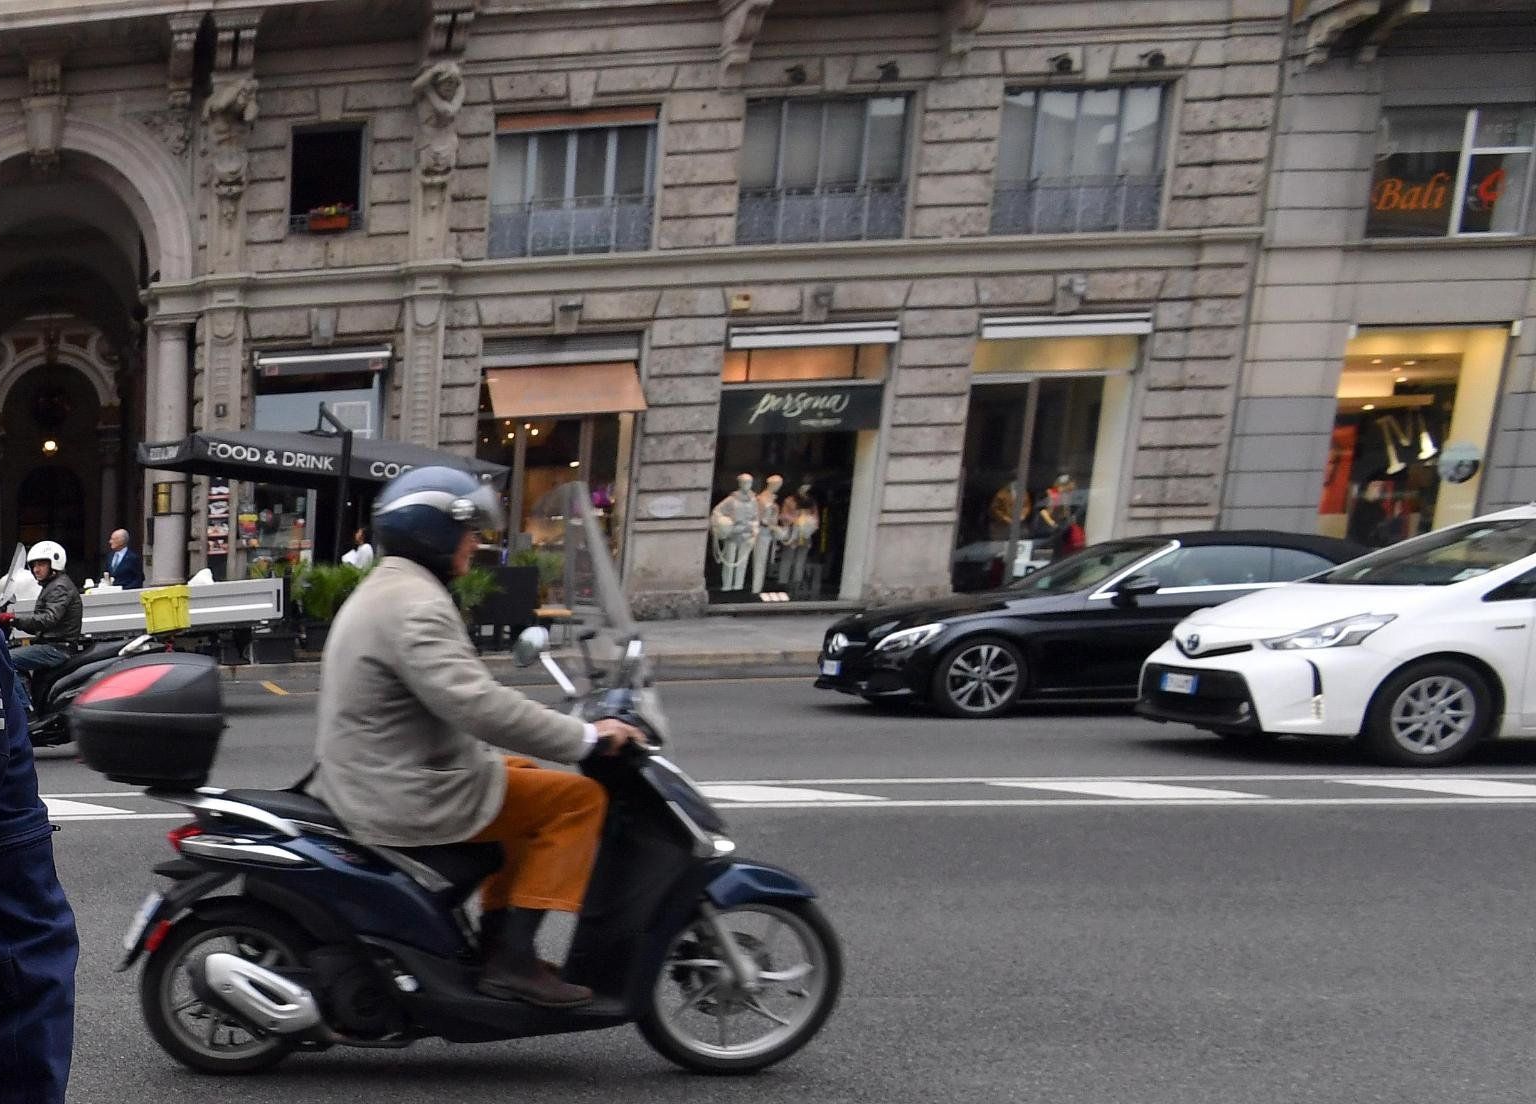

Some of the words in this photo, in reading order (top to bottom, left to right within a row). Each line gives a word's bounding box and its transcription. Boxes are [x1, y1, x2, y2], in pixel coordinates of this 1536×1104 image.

[1374, 171, 1450, 210] Bali
[748, 392, 850, 424] persona
[207, 442, 261, 462] FOOD
[266, 450, 278, 465] &
[282, 451, 334, 471] DRINK
